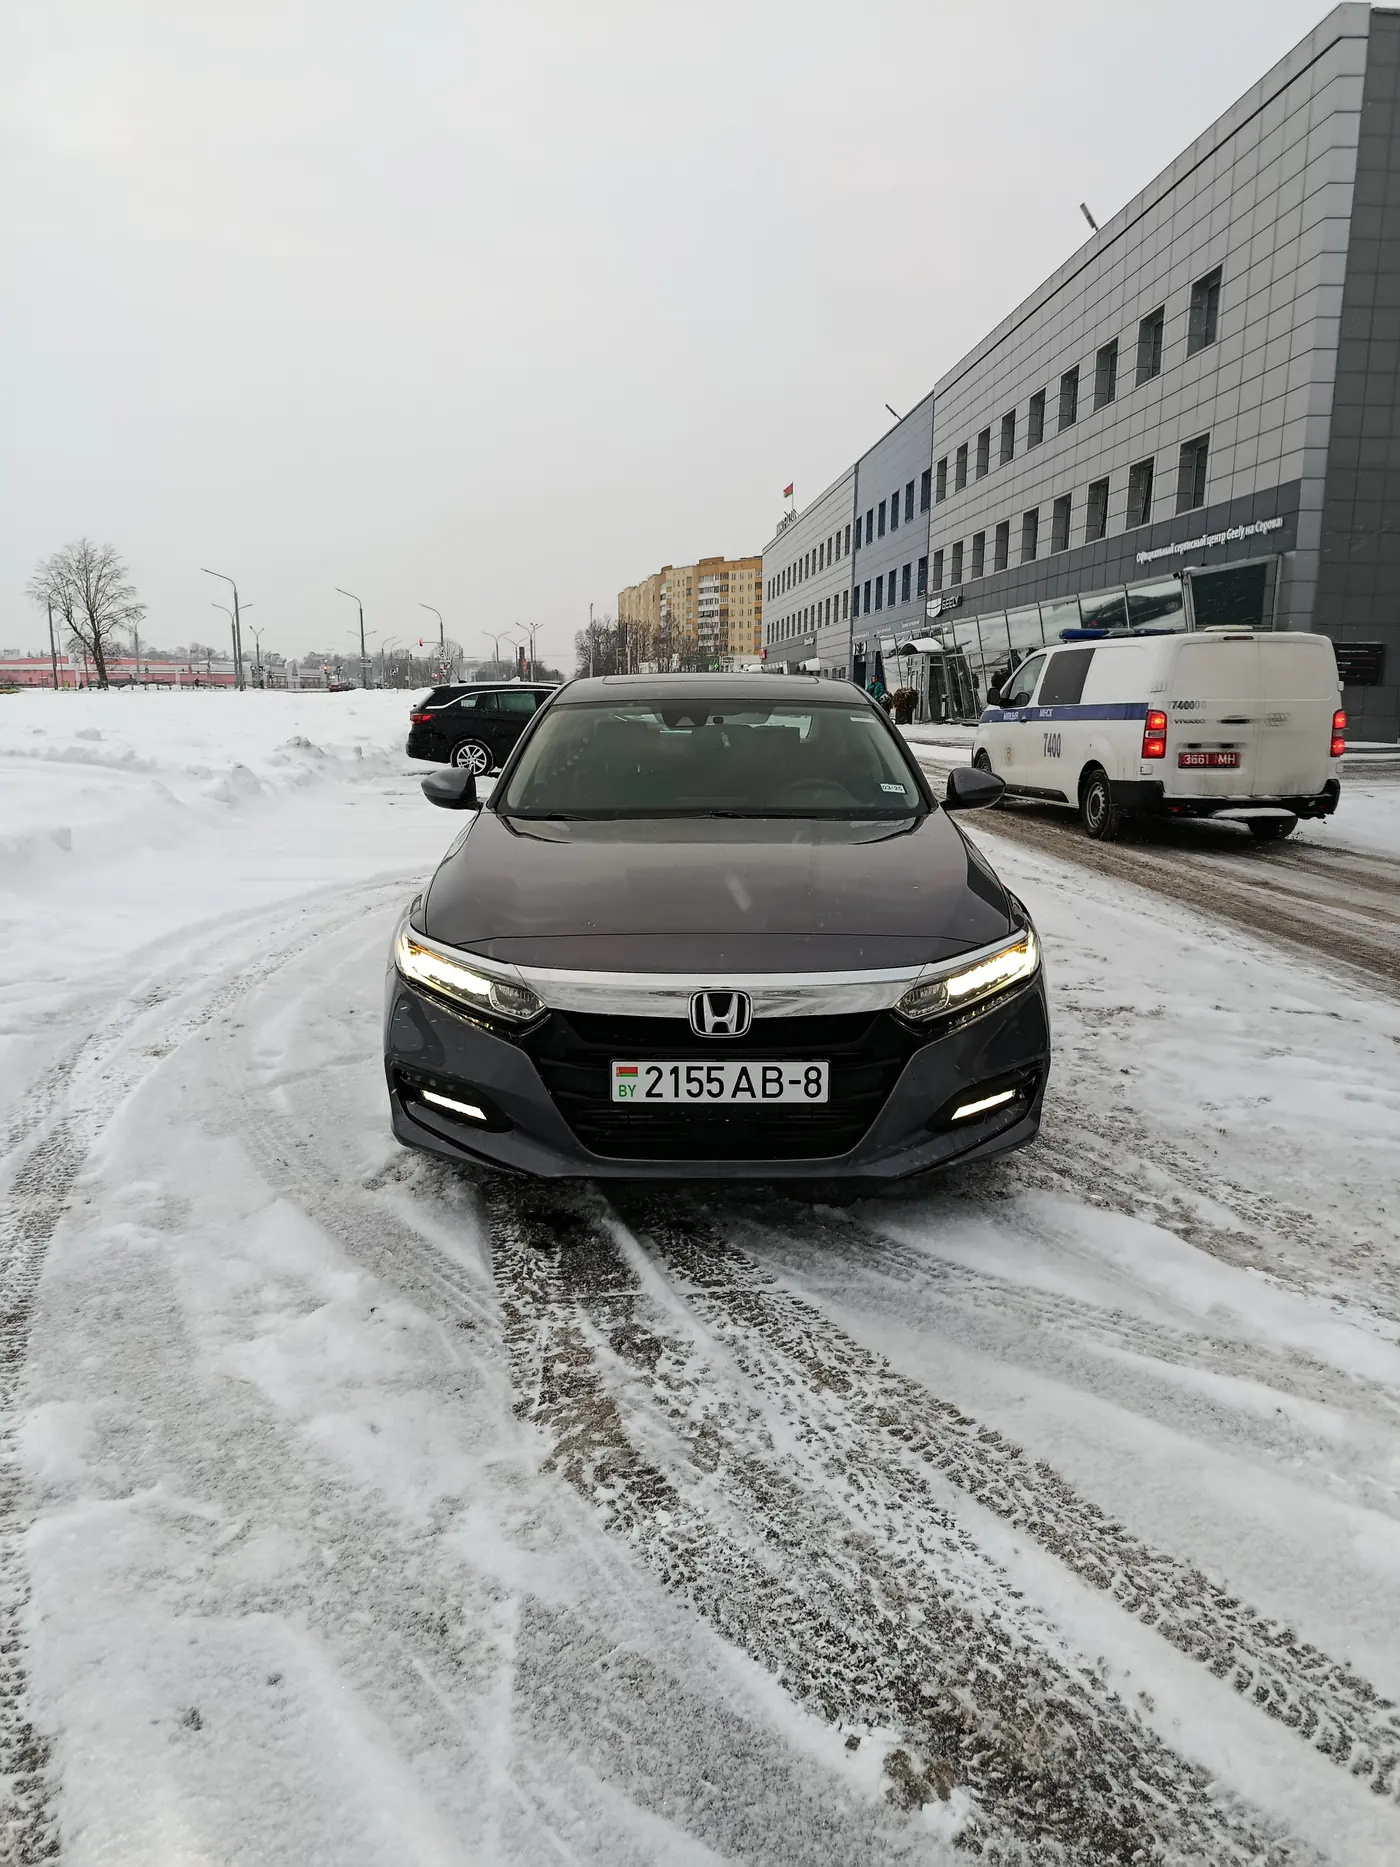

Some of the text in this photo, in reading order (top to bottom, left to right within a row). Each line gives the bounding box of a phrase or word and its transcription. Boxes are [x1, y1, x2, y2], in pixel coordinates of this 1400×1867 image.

[1043, 732, 1061, 758] 7400
[1184, 754, 1209, 765] 3661
[618, 1084, 637, 1098] BY
